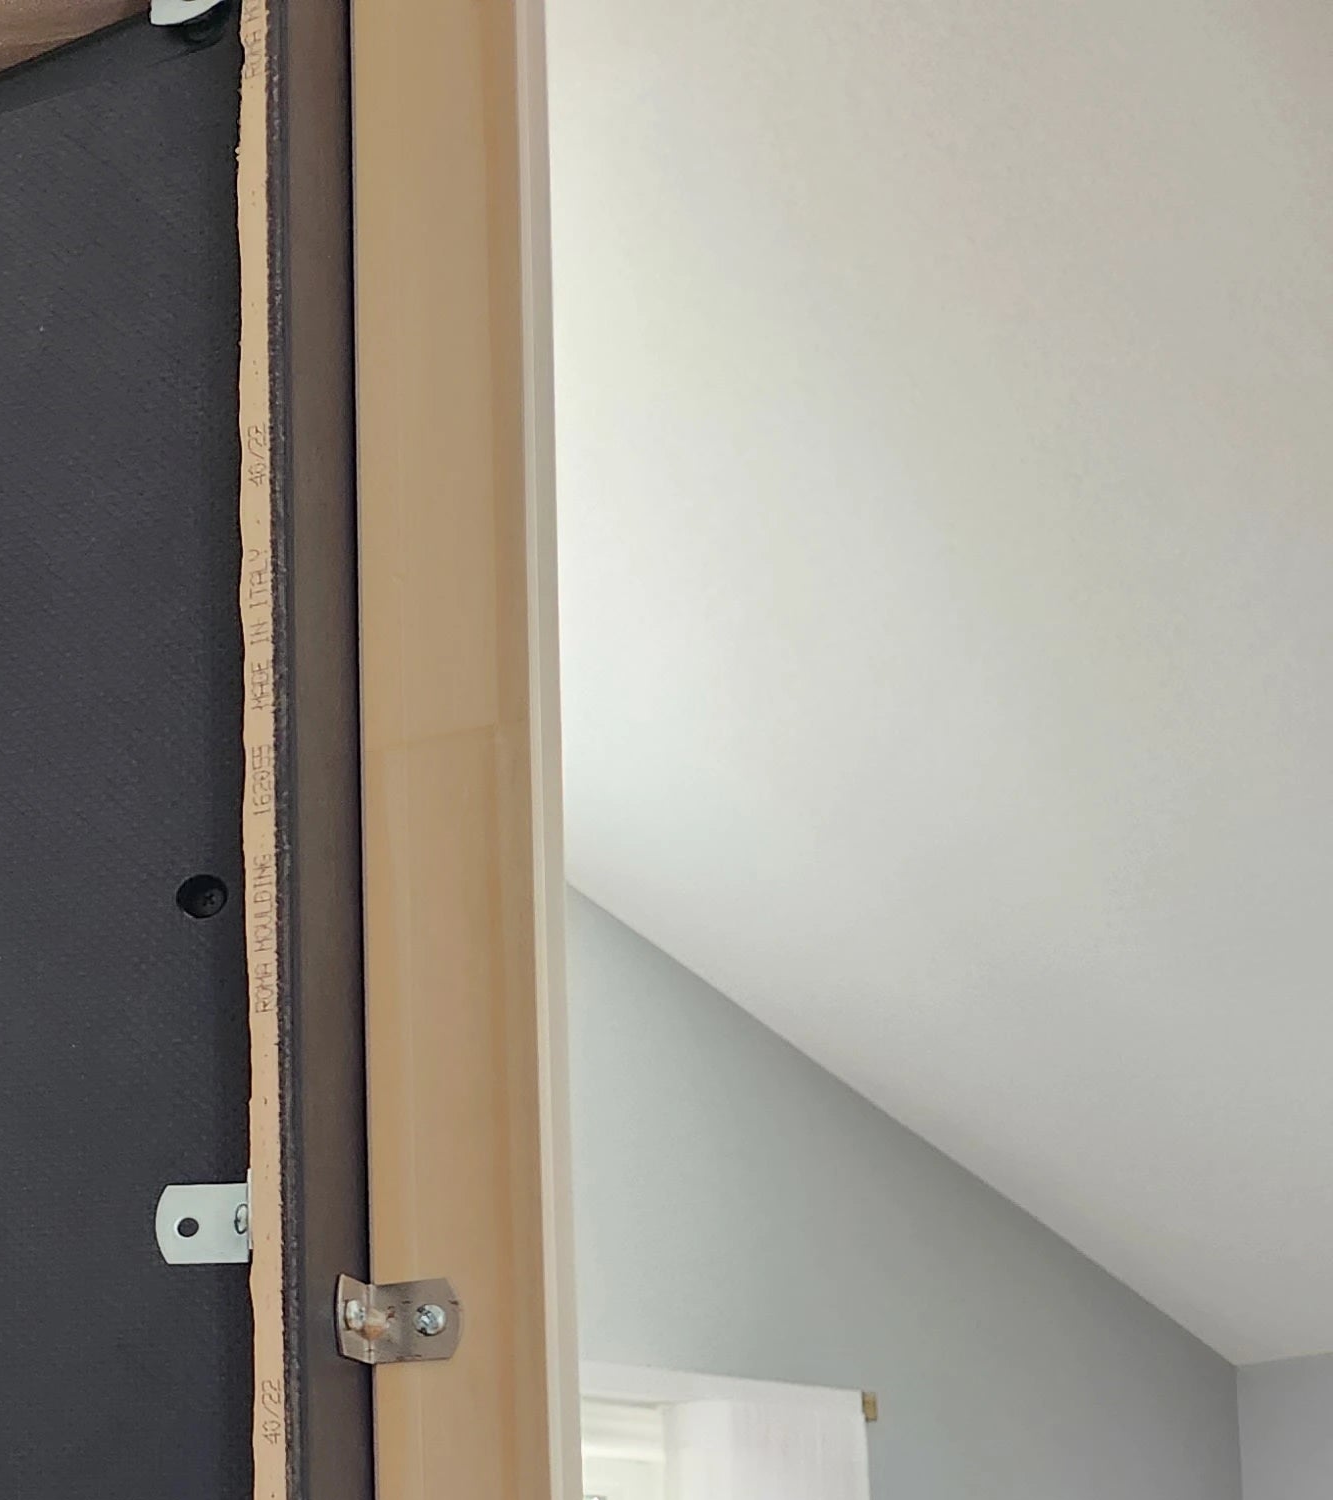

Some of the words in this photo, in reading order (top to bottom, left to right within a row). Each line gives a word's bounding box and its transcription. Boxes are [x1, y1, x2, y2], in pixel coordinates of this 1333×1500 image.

[244, 31, 263, 80] ROMA
[247, 422, 266, 487] 40/22
[249, 548, 269, 608] ITALY
[249, 618, 269, 646] IN
[250, 659, 270, 711] MADE
[251, 744, 271, 817] 162055
[252, 854, 274, 953] MOULDING
[255, 963, 274, 1014] ROMA
[261, 1378, 282, 1445] 40/22
